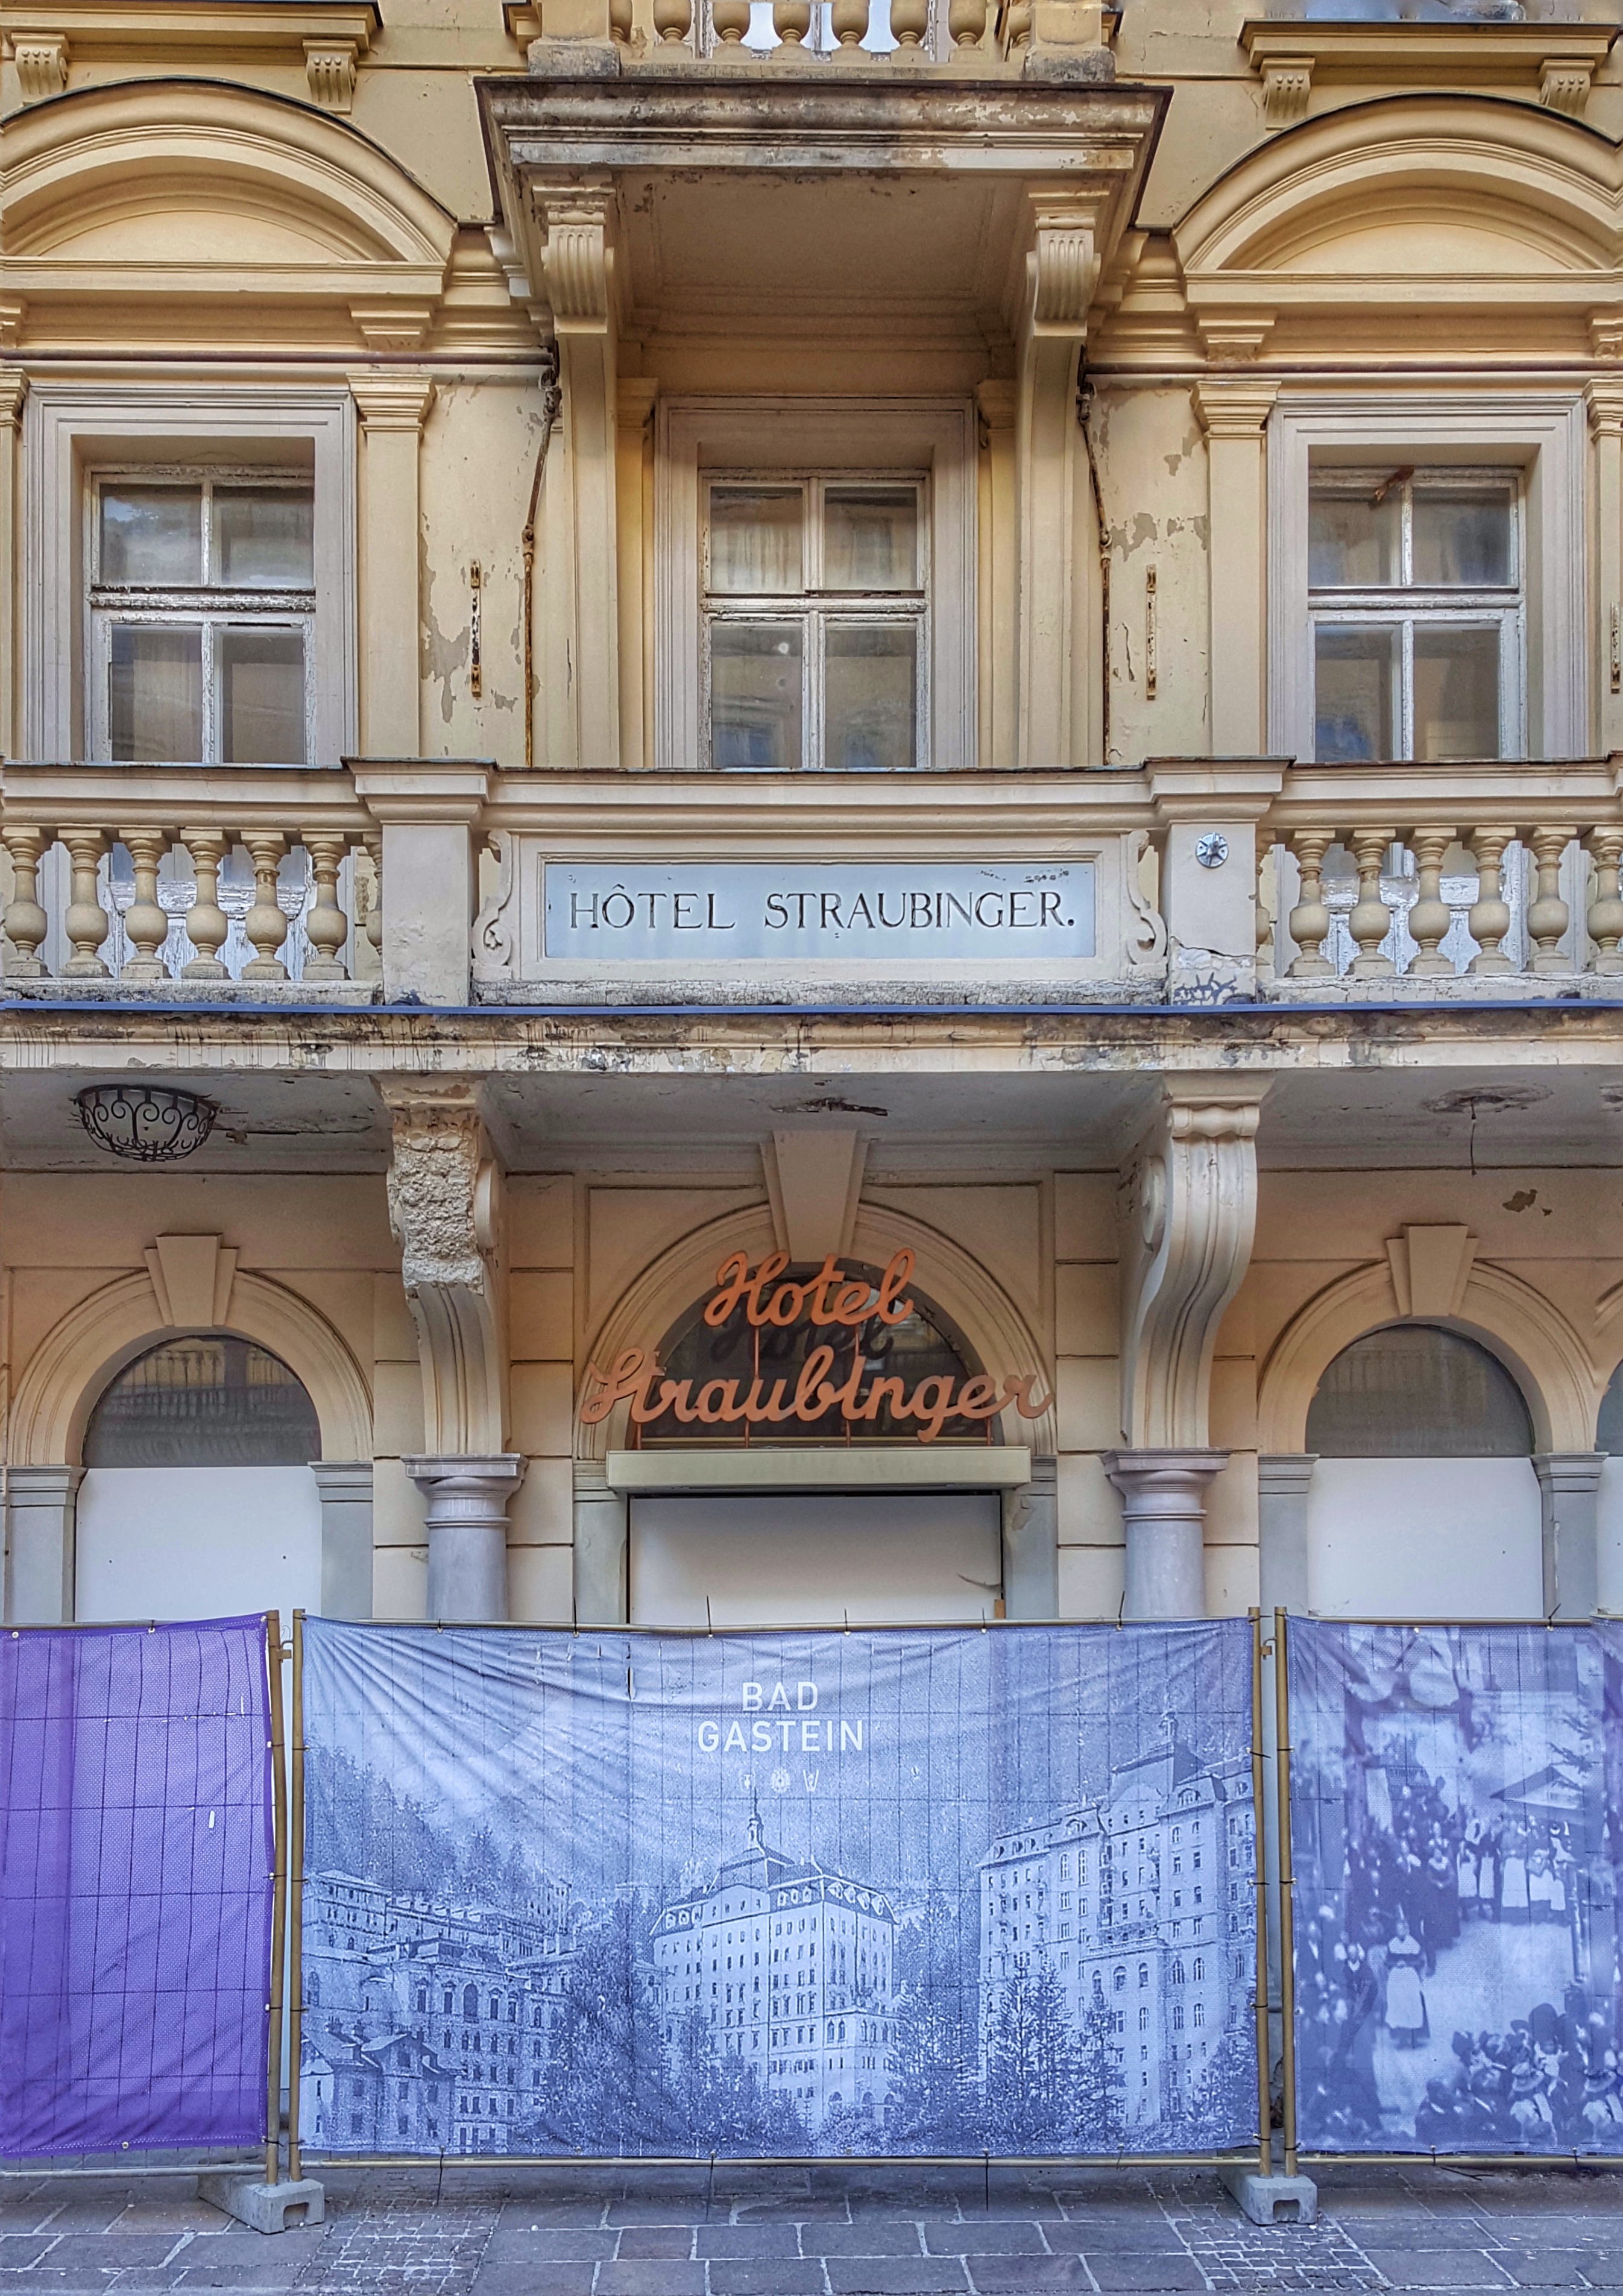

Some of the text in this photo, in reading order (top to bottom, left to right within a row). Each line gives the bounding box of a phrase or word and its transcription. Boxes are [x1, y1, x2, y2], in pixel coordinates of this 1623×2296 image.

[569, 883, 1076, 930] HÔTEL STRAUBINGER.
[704, 1247, 915, 1326] Hotel
[579, 1345, 1053, 1443] Straubinger
[742, 1681, 818, 1711] BAD
[698, 1720, 863, 1752] GASTEIN
